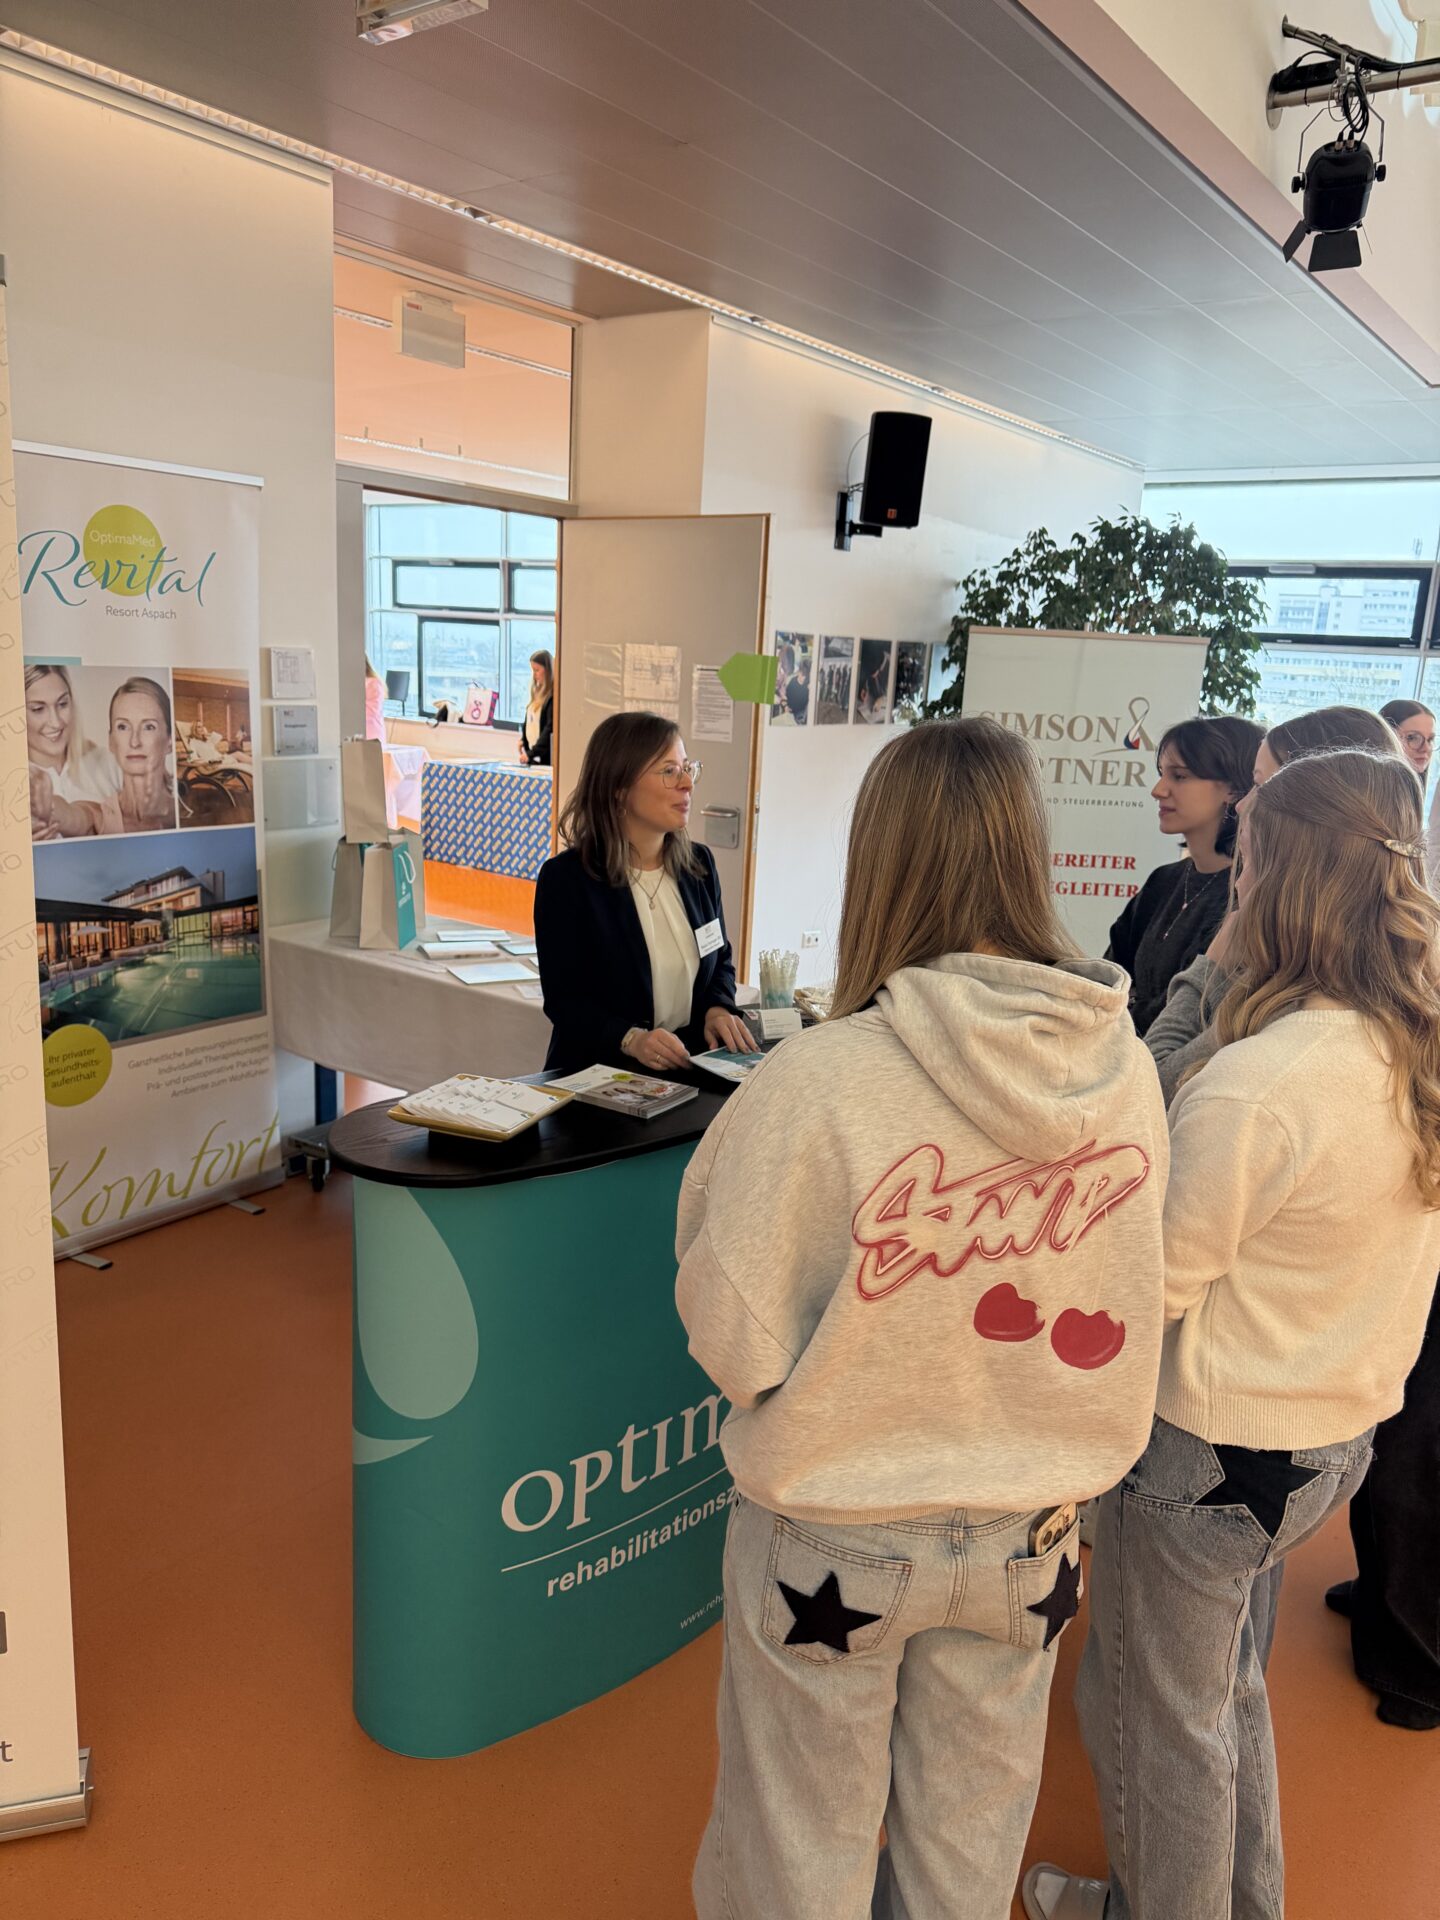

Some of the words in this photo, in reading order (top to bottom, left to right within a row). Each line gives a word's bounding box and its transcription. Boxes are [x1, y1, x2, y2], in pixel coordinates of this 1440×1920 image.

[89, 530, 156, 548] OptimaMed
[18, 530, 217, 606] Revital
[105, 605, 139, 619] Resort
[141, 607, 177, 621] Aspach
[1040, 757, 1147, 787] TNER
[1063, 798, 1144, 808] STEUERBERATUNG
[48, 1055, 60, 1064] Ihr
[62, 1047, 96, 1063] privater
[51, 1070, 97, 1088] aufenthalt
[49, 1111, 280, 1238] Komfort
